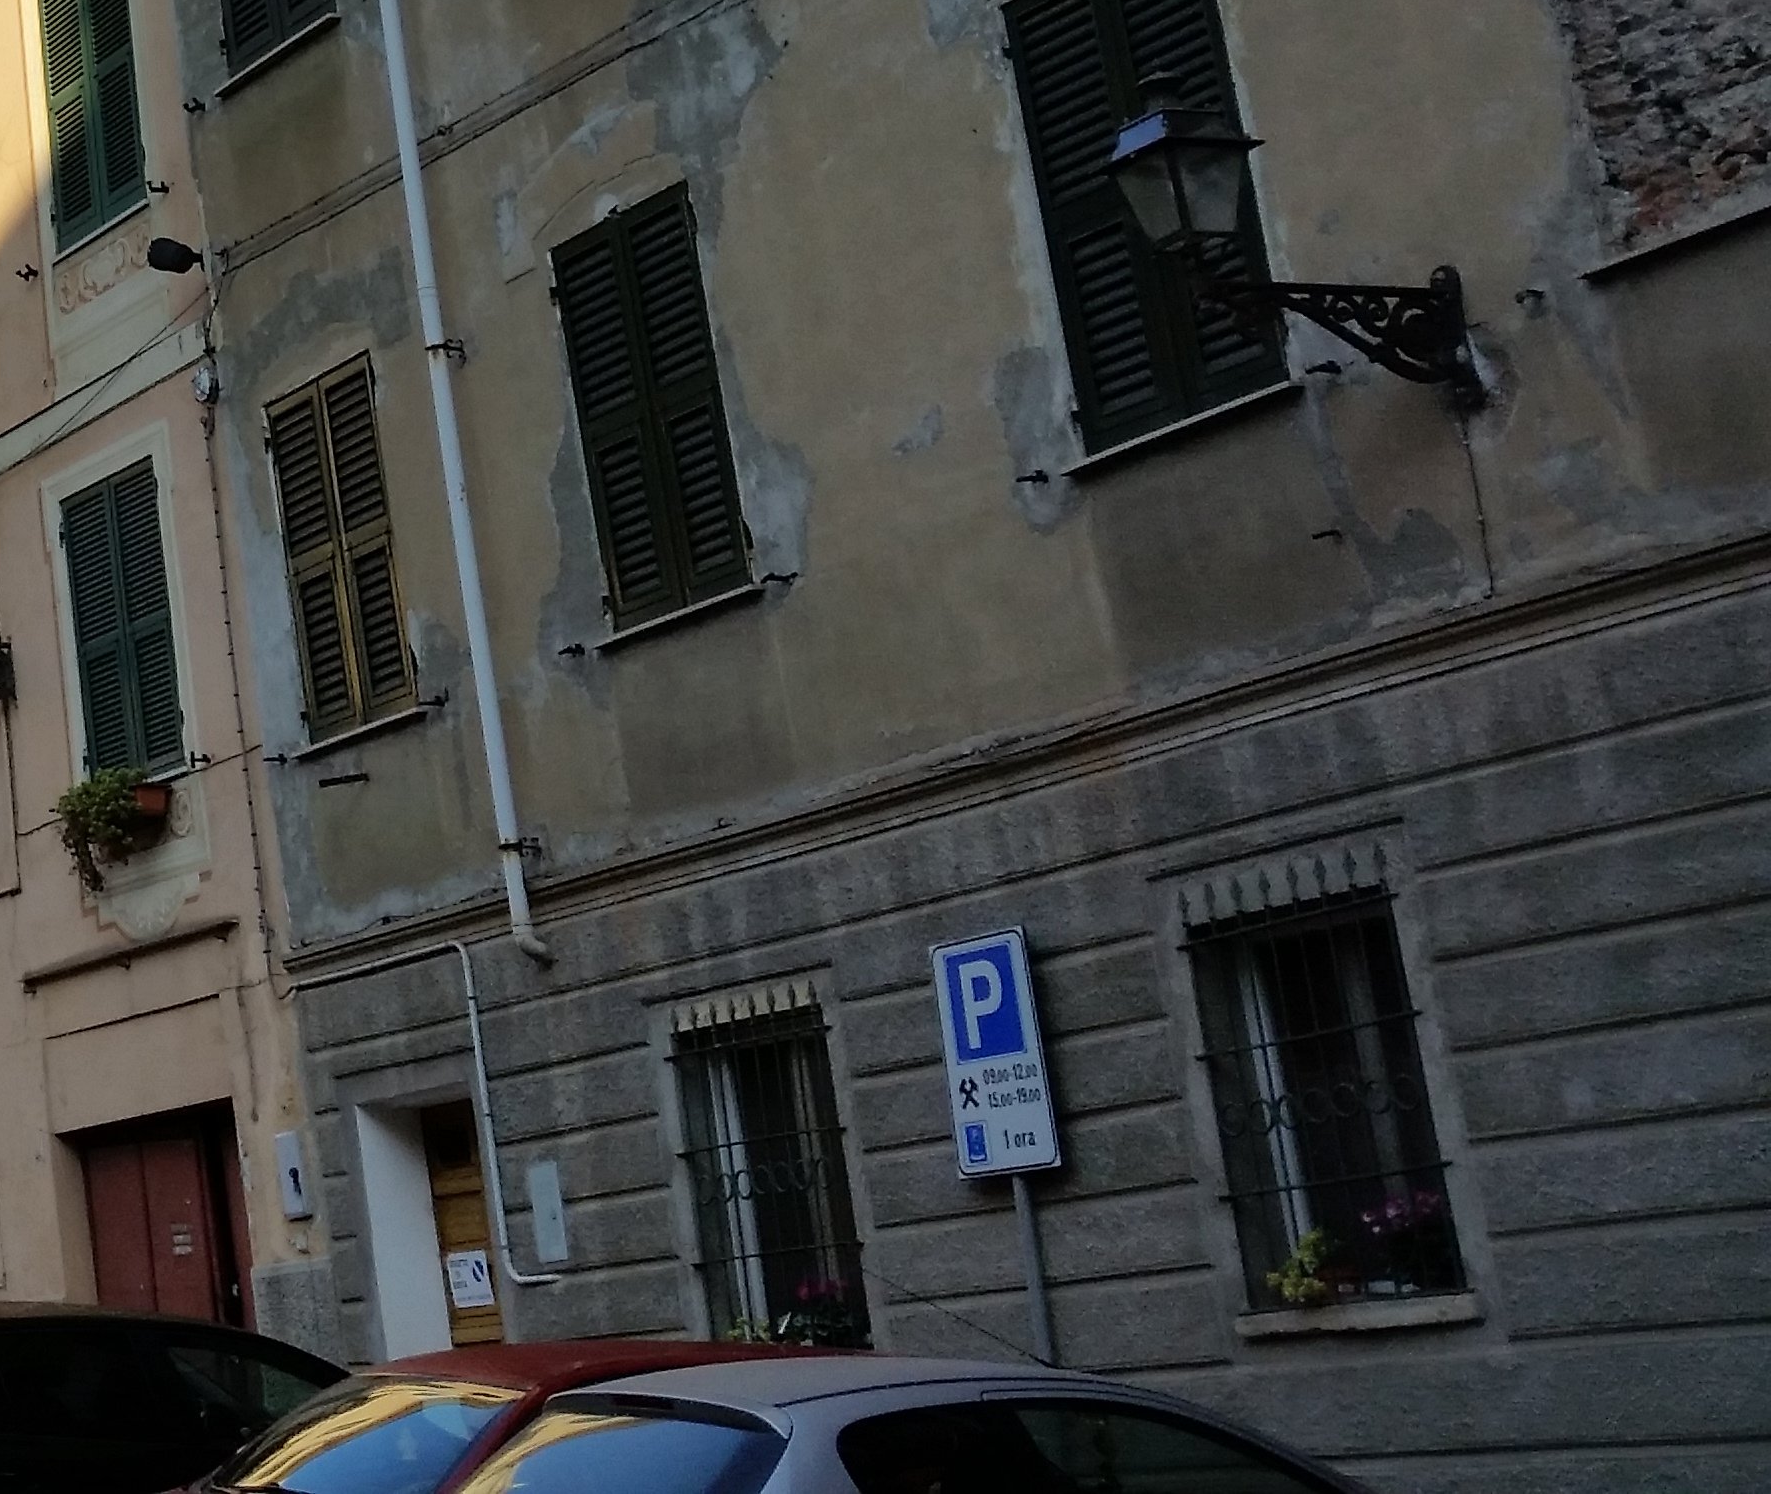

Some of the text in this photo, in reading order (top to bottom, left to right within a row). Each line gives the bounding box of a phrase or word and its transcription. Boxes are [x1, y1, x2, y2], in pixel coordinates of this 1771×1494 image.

[958, 960, 1003, 1049] P
[1004, 1129, 1036, 1150] 1 ora
